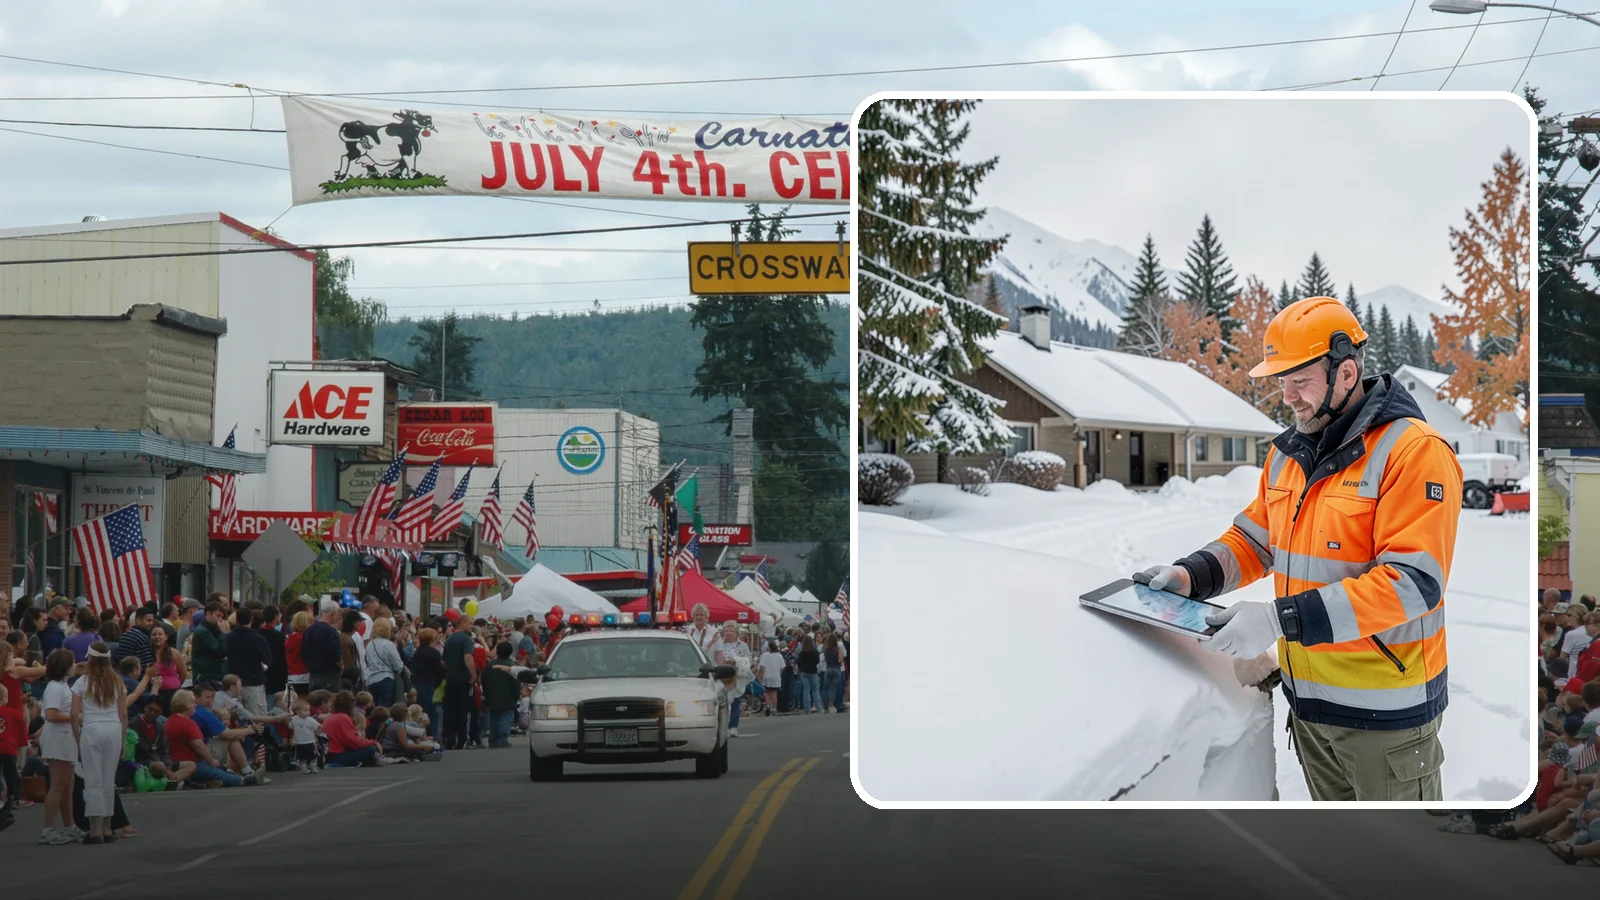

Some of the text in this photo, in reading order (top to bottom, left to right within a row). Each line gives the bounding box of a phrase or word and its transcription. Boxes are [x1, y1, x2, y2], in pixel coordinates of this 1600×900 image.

[481, 141, 604, 192] JULY
[632, 150, 746, 197] 4th.
[697, 254, 850, 280] CROSSWA
[282, 380, 373, 420] ACE
[406, 409, 452, 422] CEDAR
[283, 421, 370, 437] Hardware
[416, 428, 477, 447] Coca-Cola
[354, 467, 386, 481] Simpl
[83, 485, 155, 496] St. Vincent de Paul
[213, 516, 331, 535] HARDARE
[688, 526, 741, 535] CRNATION
[699, 535, 730, 544] GLASS
